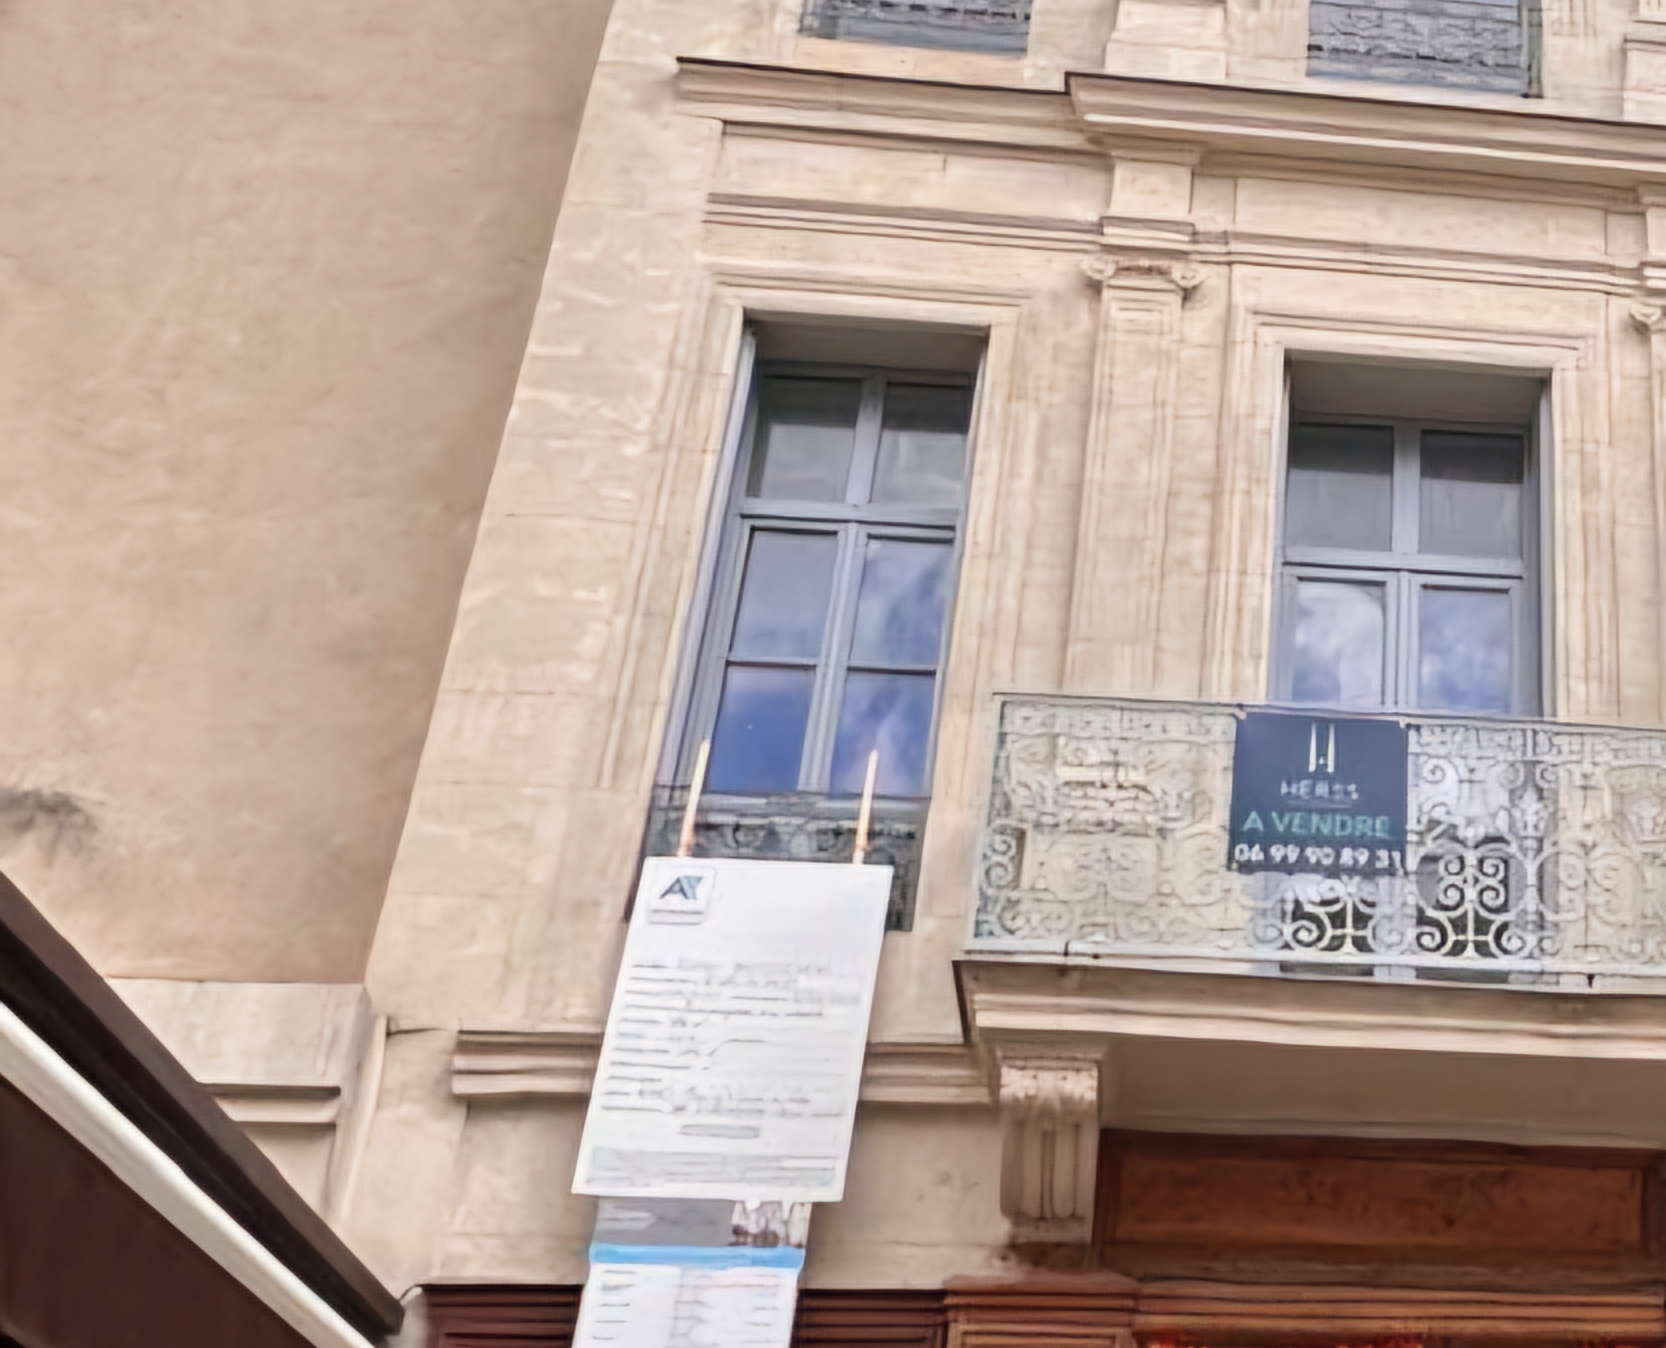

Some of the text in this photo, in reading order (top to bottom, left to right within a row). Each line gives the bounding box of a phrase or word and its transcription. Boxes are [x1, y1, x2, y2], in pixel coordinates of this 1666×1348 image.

[1242, 810, 1390, 839] A VENDRE
[1234, 843, 1265, 862] 06
